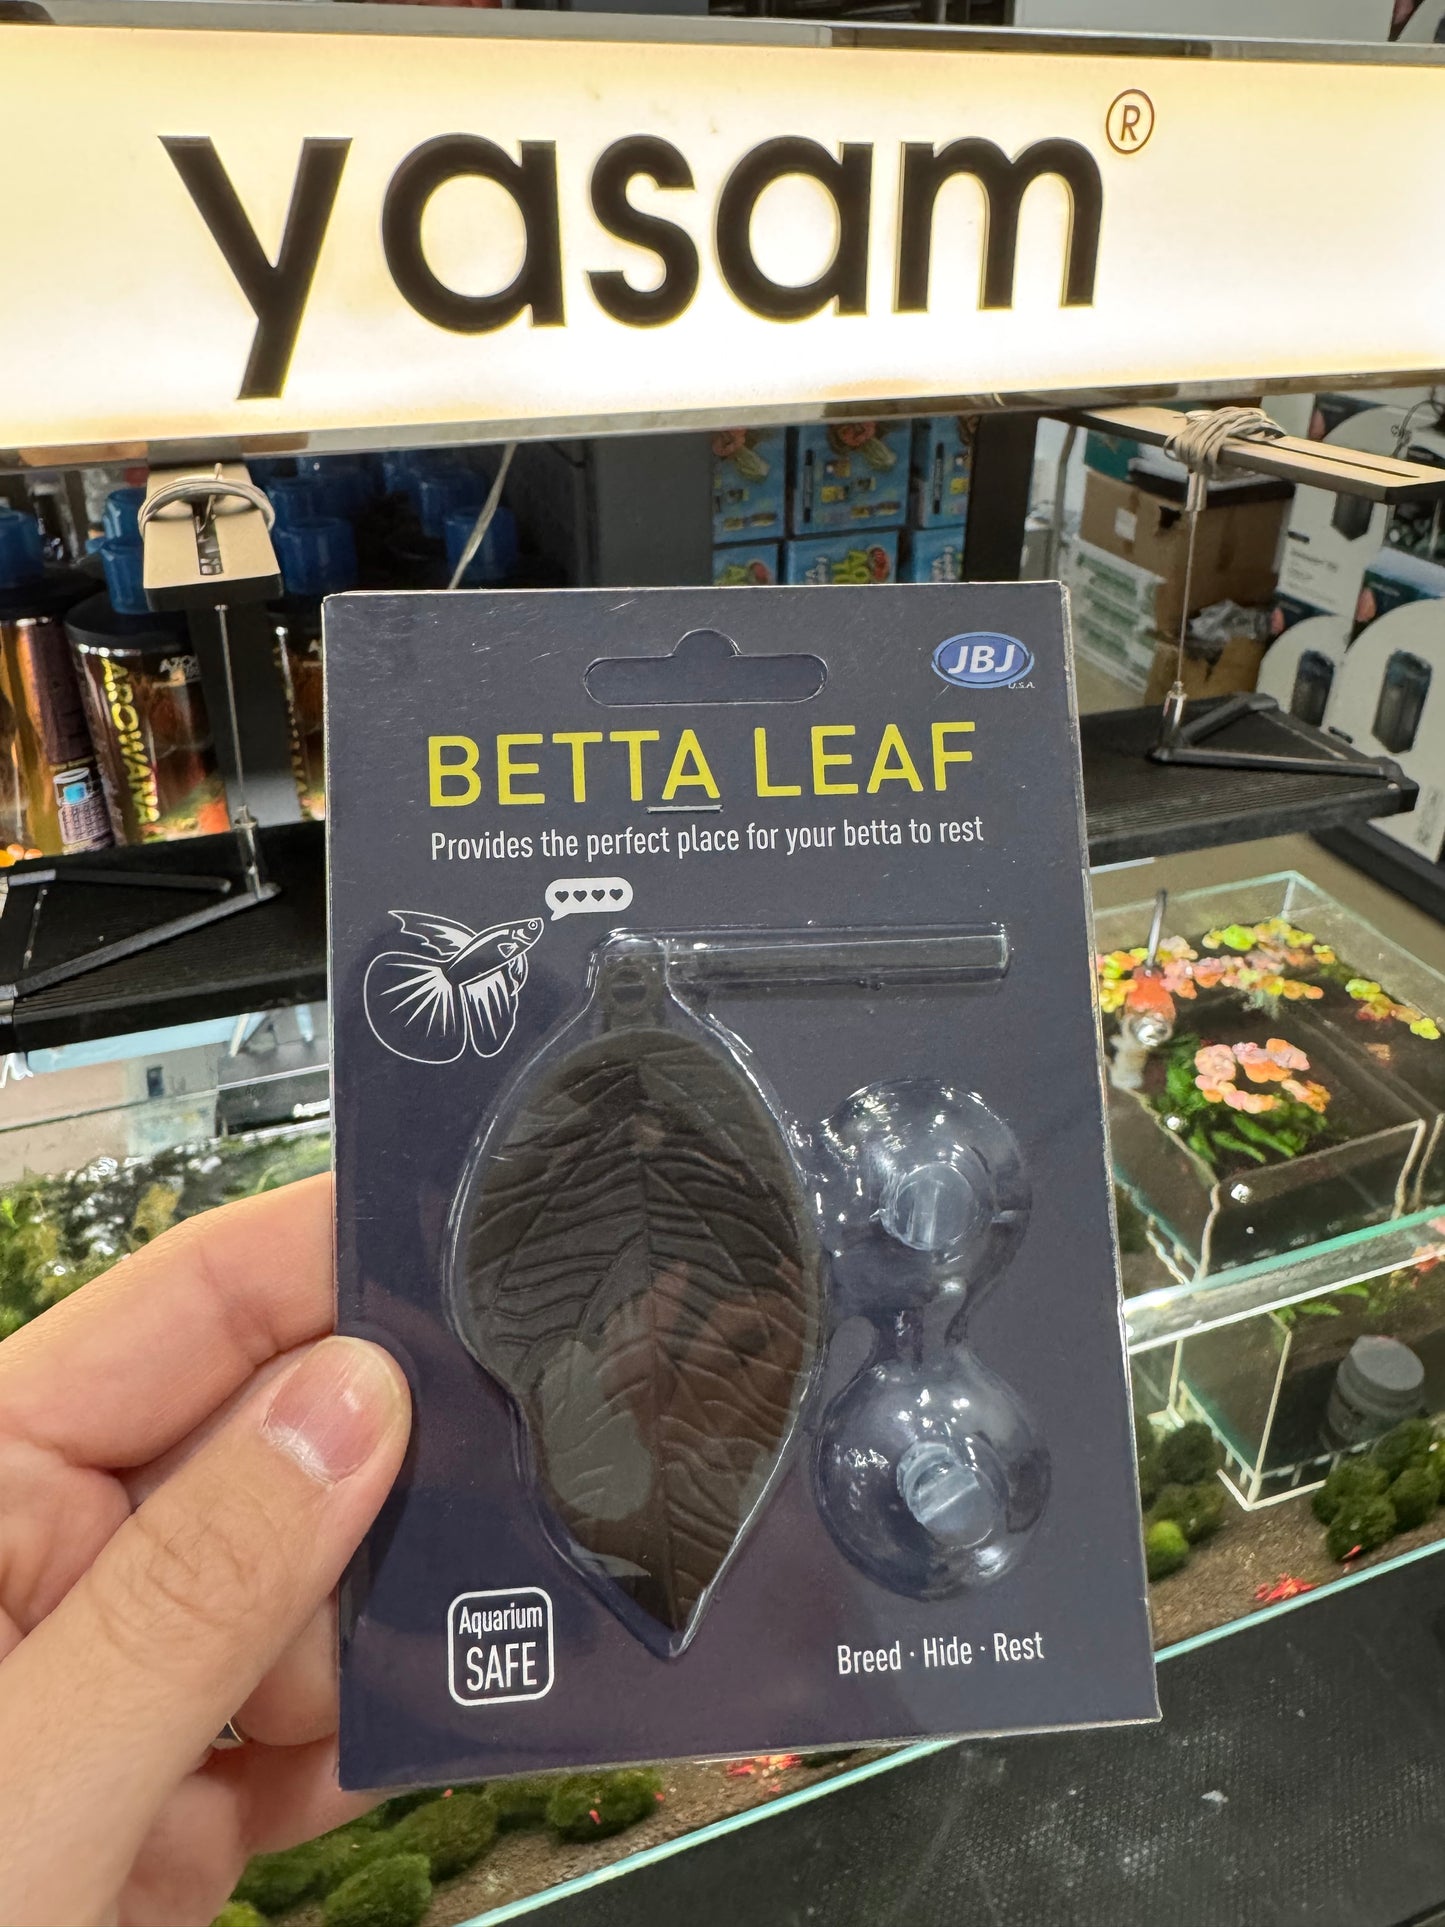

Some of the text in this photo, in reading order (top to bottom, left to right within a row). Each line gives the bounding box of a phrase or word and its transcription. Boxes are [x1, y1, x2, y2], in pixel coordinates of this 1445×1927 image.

[157, 133, 1104, 400] yasam
[947, 644, 1016, 674] JBJ
[428, 721, 976, 807] BETTA LEAF
[431, 816, 984, 863] Provides the perfect place for your betta to rest
[458, 1602, 543, 1639] Aquarium
[466, 1641, 537, 1691] SAFE
[837, 1631, 1044, 1675] Breed Hide Rest
